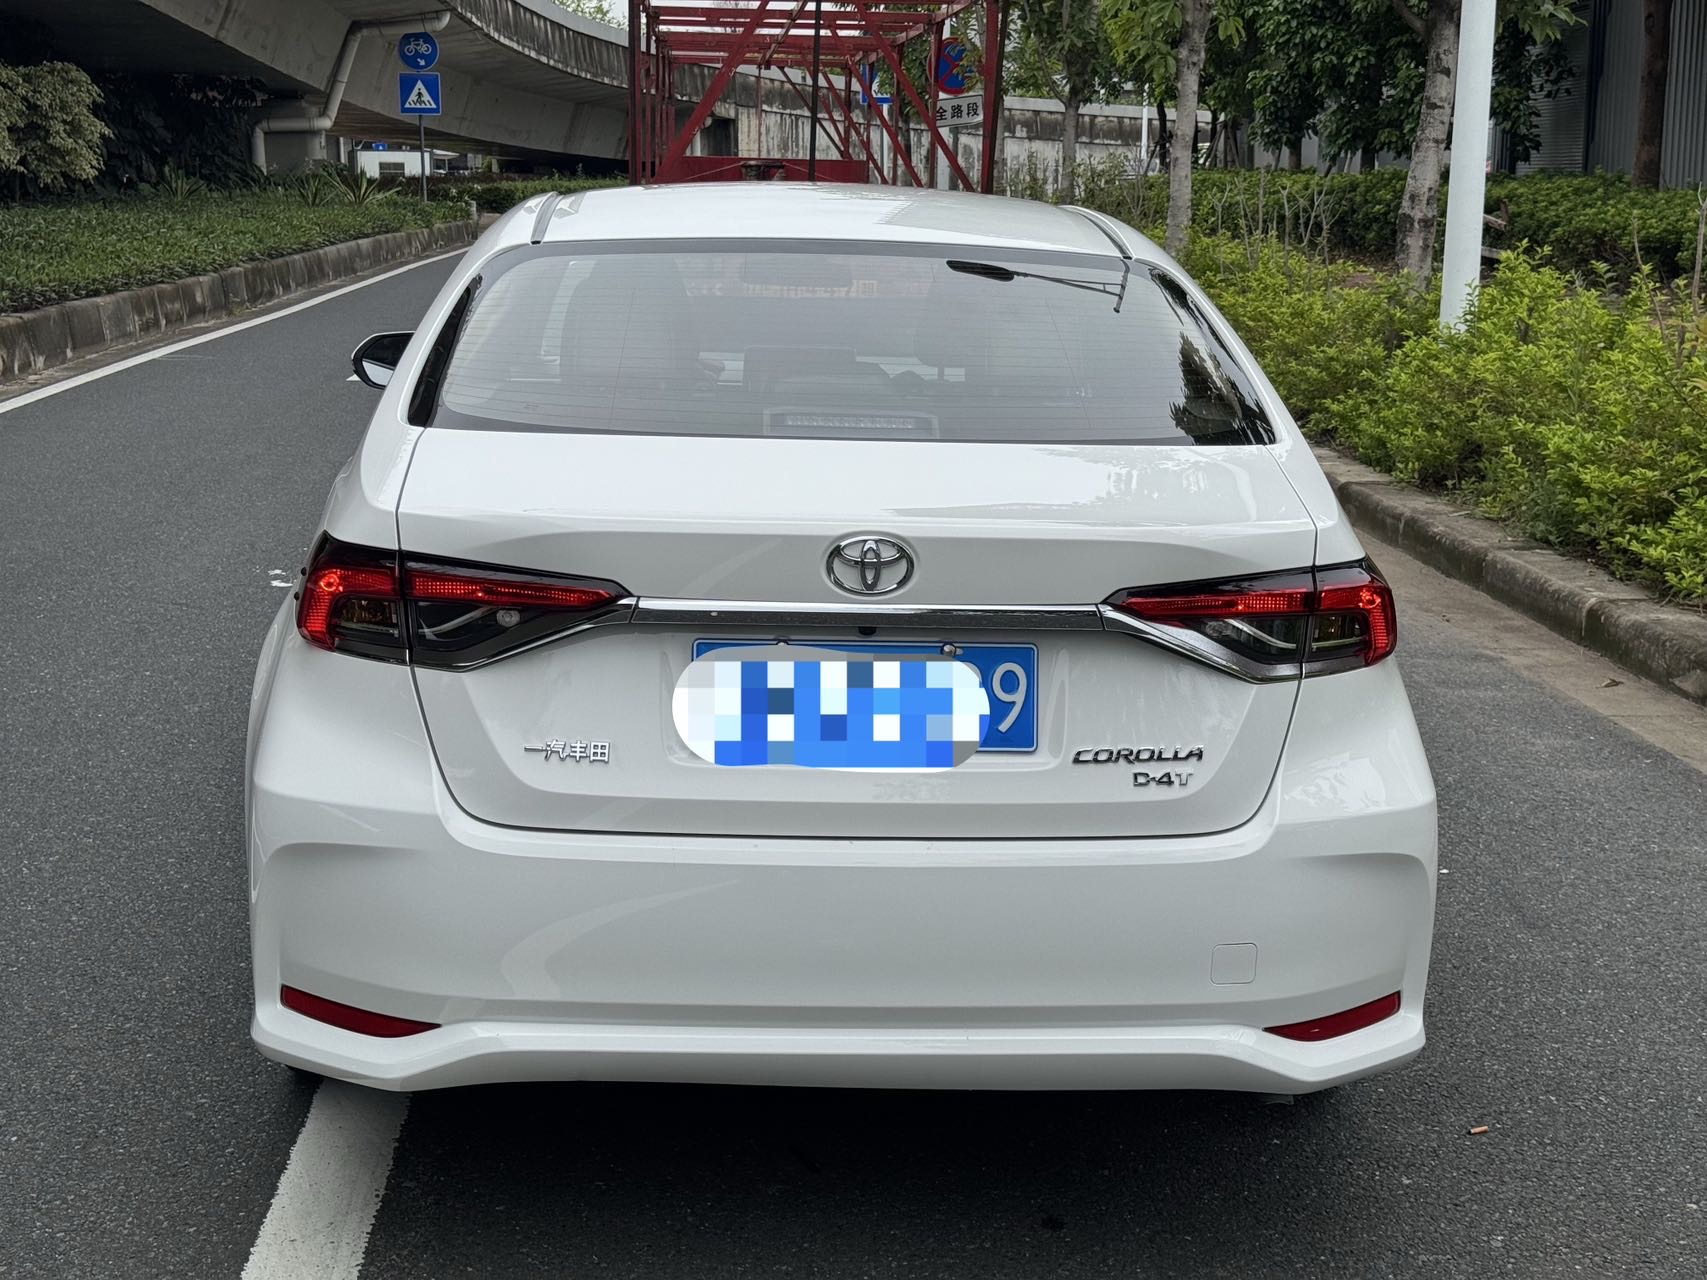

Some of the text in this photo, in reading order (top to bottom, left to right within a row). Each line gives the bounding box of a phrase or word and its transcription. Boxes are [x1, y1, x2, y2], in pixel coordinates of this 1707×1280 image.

[936, 102, 979, 121] 全路段
[524, 739, 610, 762] 一汽丰田
[1072, 746, 1204, 764] COROLLA
[1133, 770, 1193, 787] D-4T
